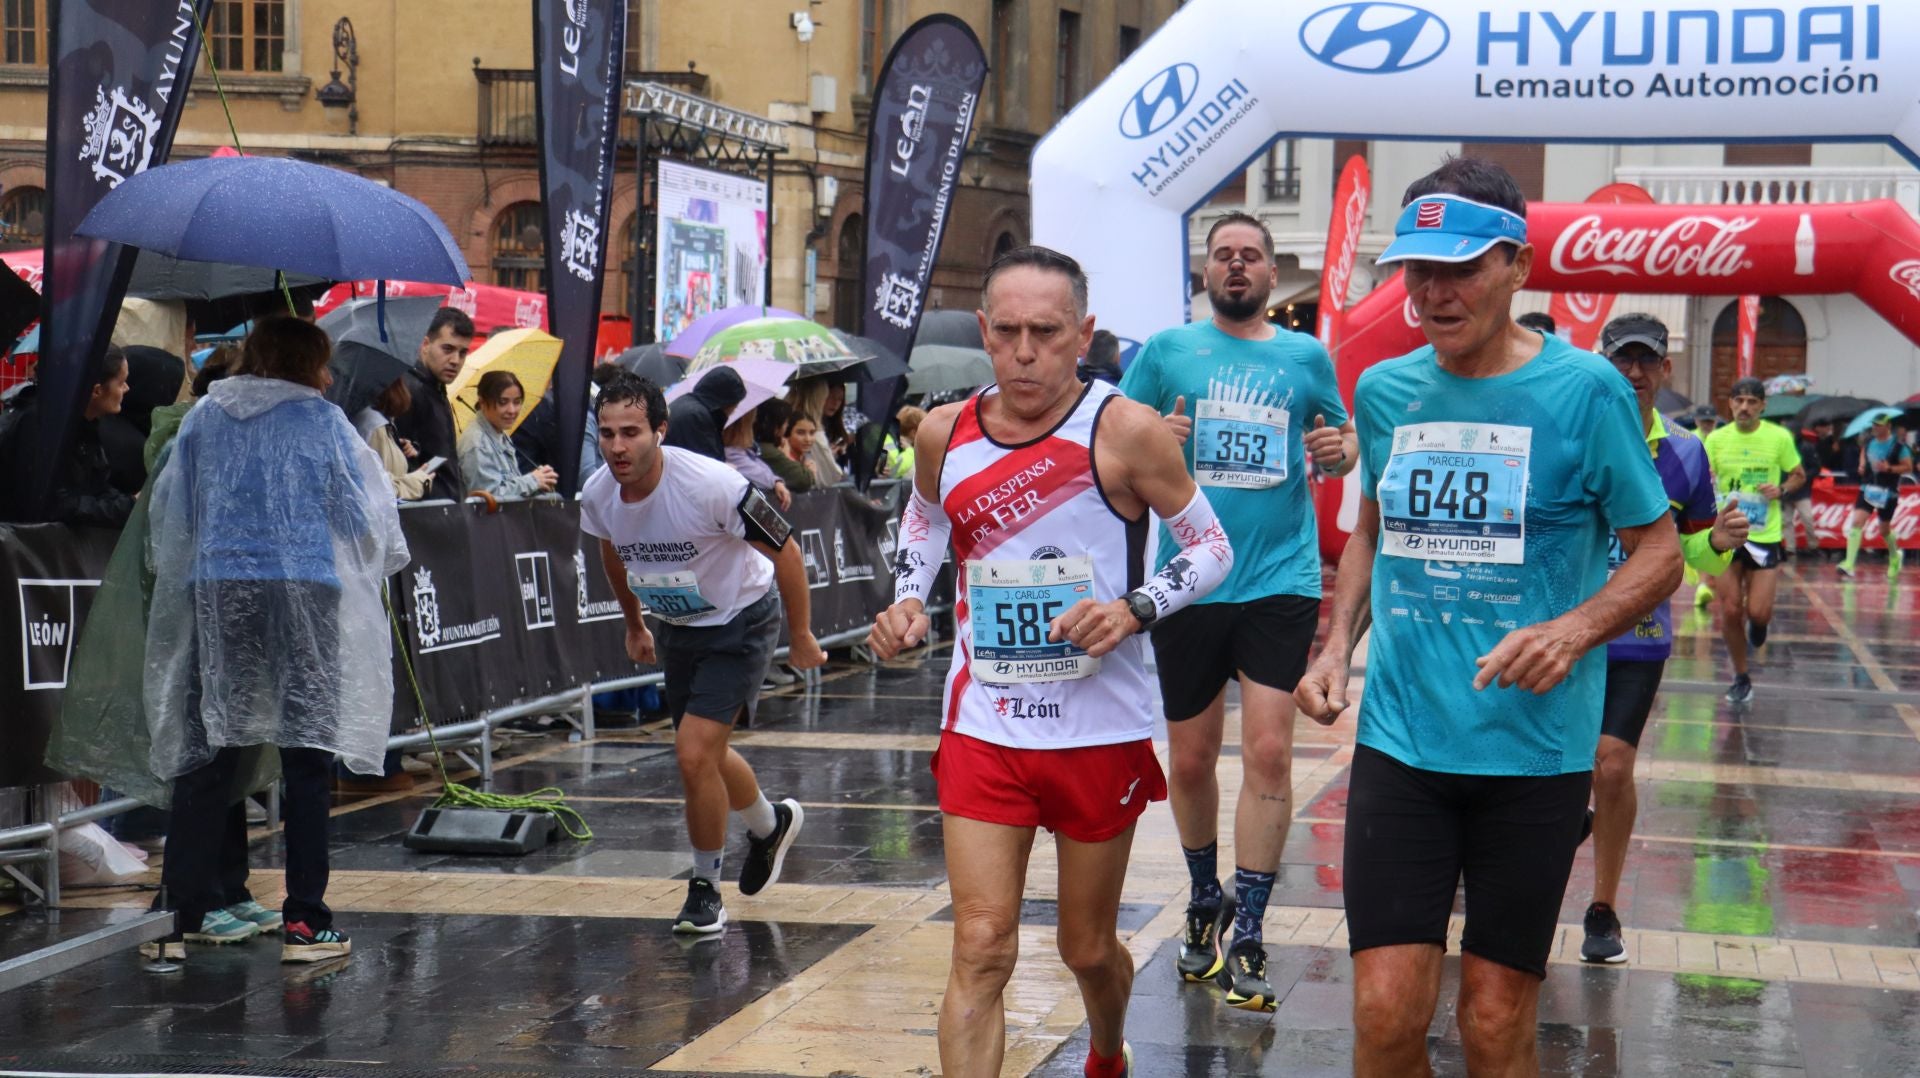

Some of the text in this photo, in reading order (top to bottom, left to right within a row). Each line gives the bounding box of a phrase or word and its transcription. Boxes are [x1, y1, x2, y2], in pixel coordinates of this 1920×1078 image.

[1476, 4, 1880, 67] HYUNDAI
[1475, 67, 1879, 98] Lemauto Automoción
[1131, 78, 1249, 188] HYUNDAI
[1149, 97, 1259, 197] Lemauto Automoción
[917, 161, 956, 282] AYUNTAMIENTO
[948, 137, 960, 158] DE
[955, 92, 973, 134] LEÓN
[1550, 214, 1759, 277] Coca-Cola
[1216, 430, 1267, 465] 353
[1490, 432, 1498, 443] k
[1427, 455, 1475, 467] MARCELO
[957, 507, 976, 525] LA
[974, 457, 1056, 513] DESPENSA
[1227, 473, 1271, 484] HYUNDAI
[1408, 469, 1489, 520] 648
[971, 489, 1048, 544] DE FER
[636, 553, 653, 562] THE
[655, 549, 699, 562] BRUNCH
[639, 541, 694, 553] RUNNING
[1427, 538, 1496, 551] HYUNDAI
[991, 568, 998, 578] k
[1058, 565, 1065, 575] k
[1015, 590, 1050, 600] CARLOS
[29, 613, 66, 646] LEÓN
[995, 601, 1065, 646] 585
[1016, 659, 1079, 673] HYUNDAI
[1010, 696, 1061, 719] León
